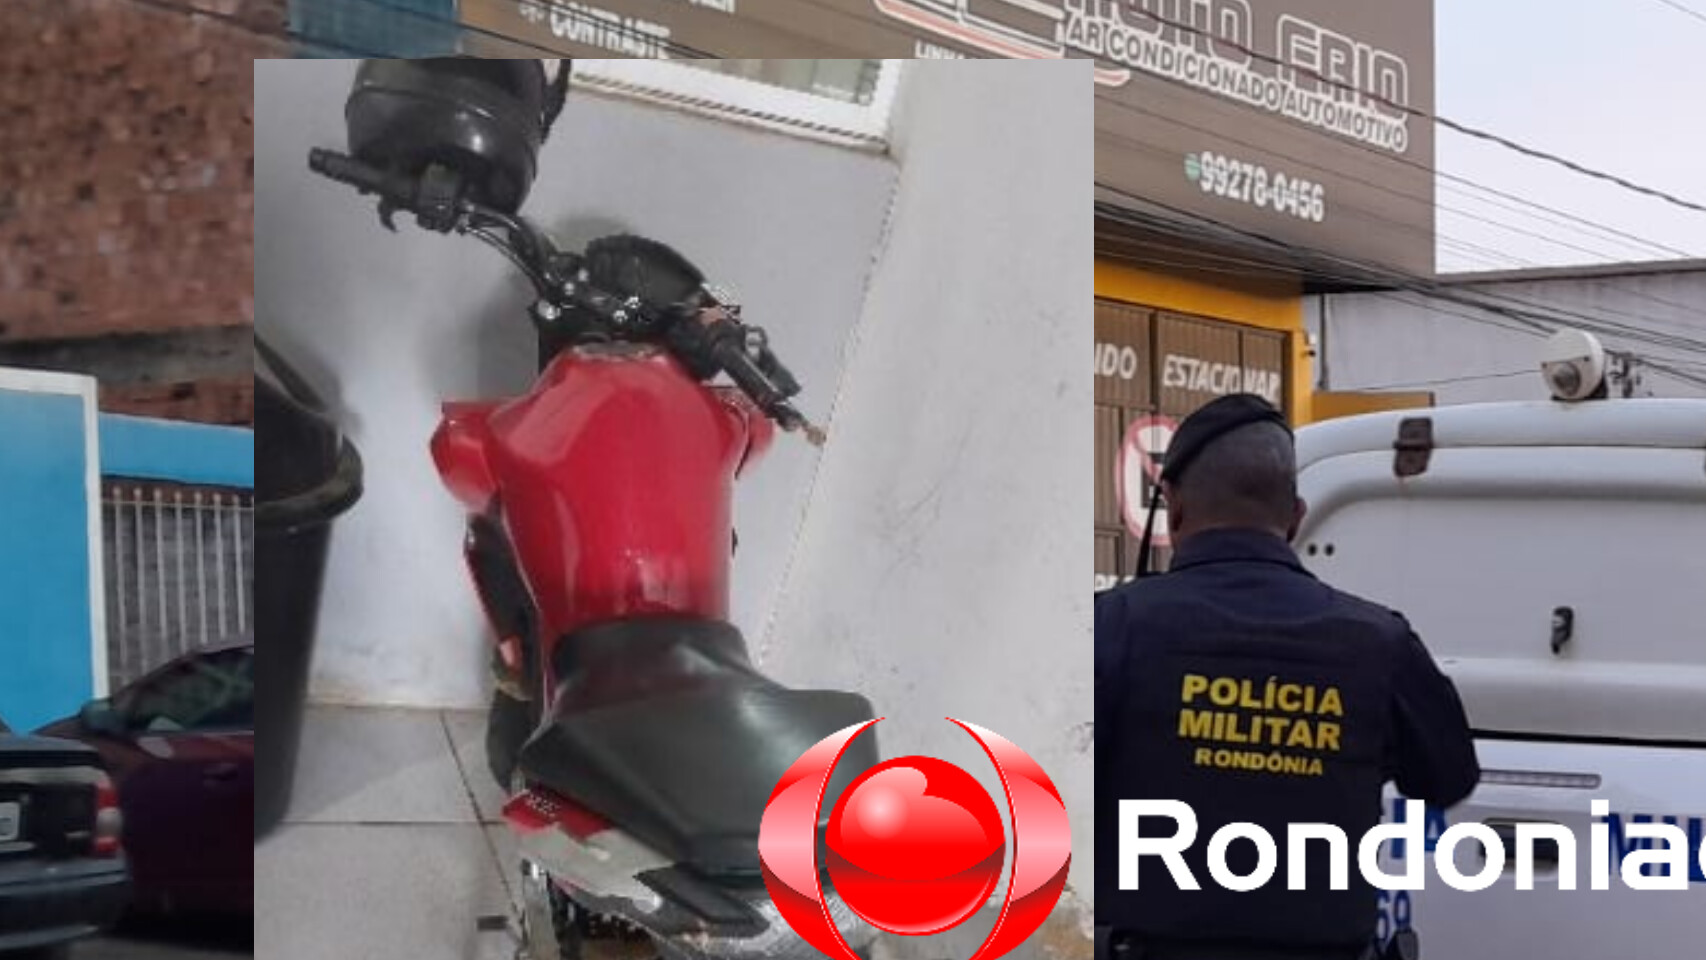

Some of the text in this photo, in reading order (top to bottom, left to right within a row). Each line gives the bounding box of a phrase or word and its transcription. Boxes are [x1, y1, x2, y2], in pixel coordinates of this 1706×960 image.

[1066, 12, 1408, 153] AR CONDICIONADO AUTOMOTIVO
[1200, 150, 1325, 222] 99278-0456
[1181, 674, 1343, 717] POLÍCIA
[1178, 708, 1341, 751] MILITAR
[1194, 747, 1324, 776] RONDÔNIA
